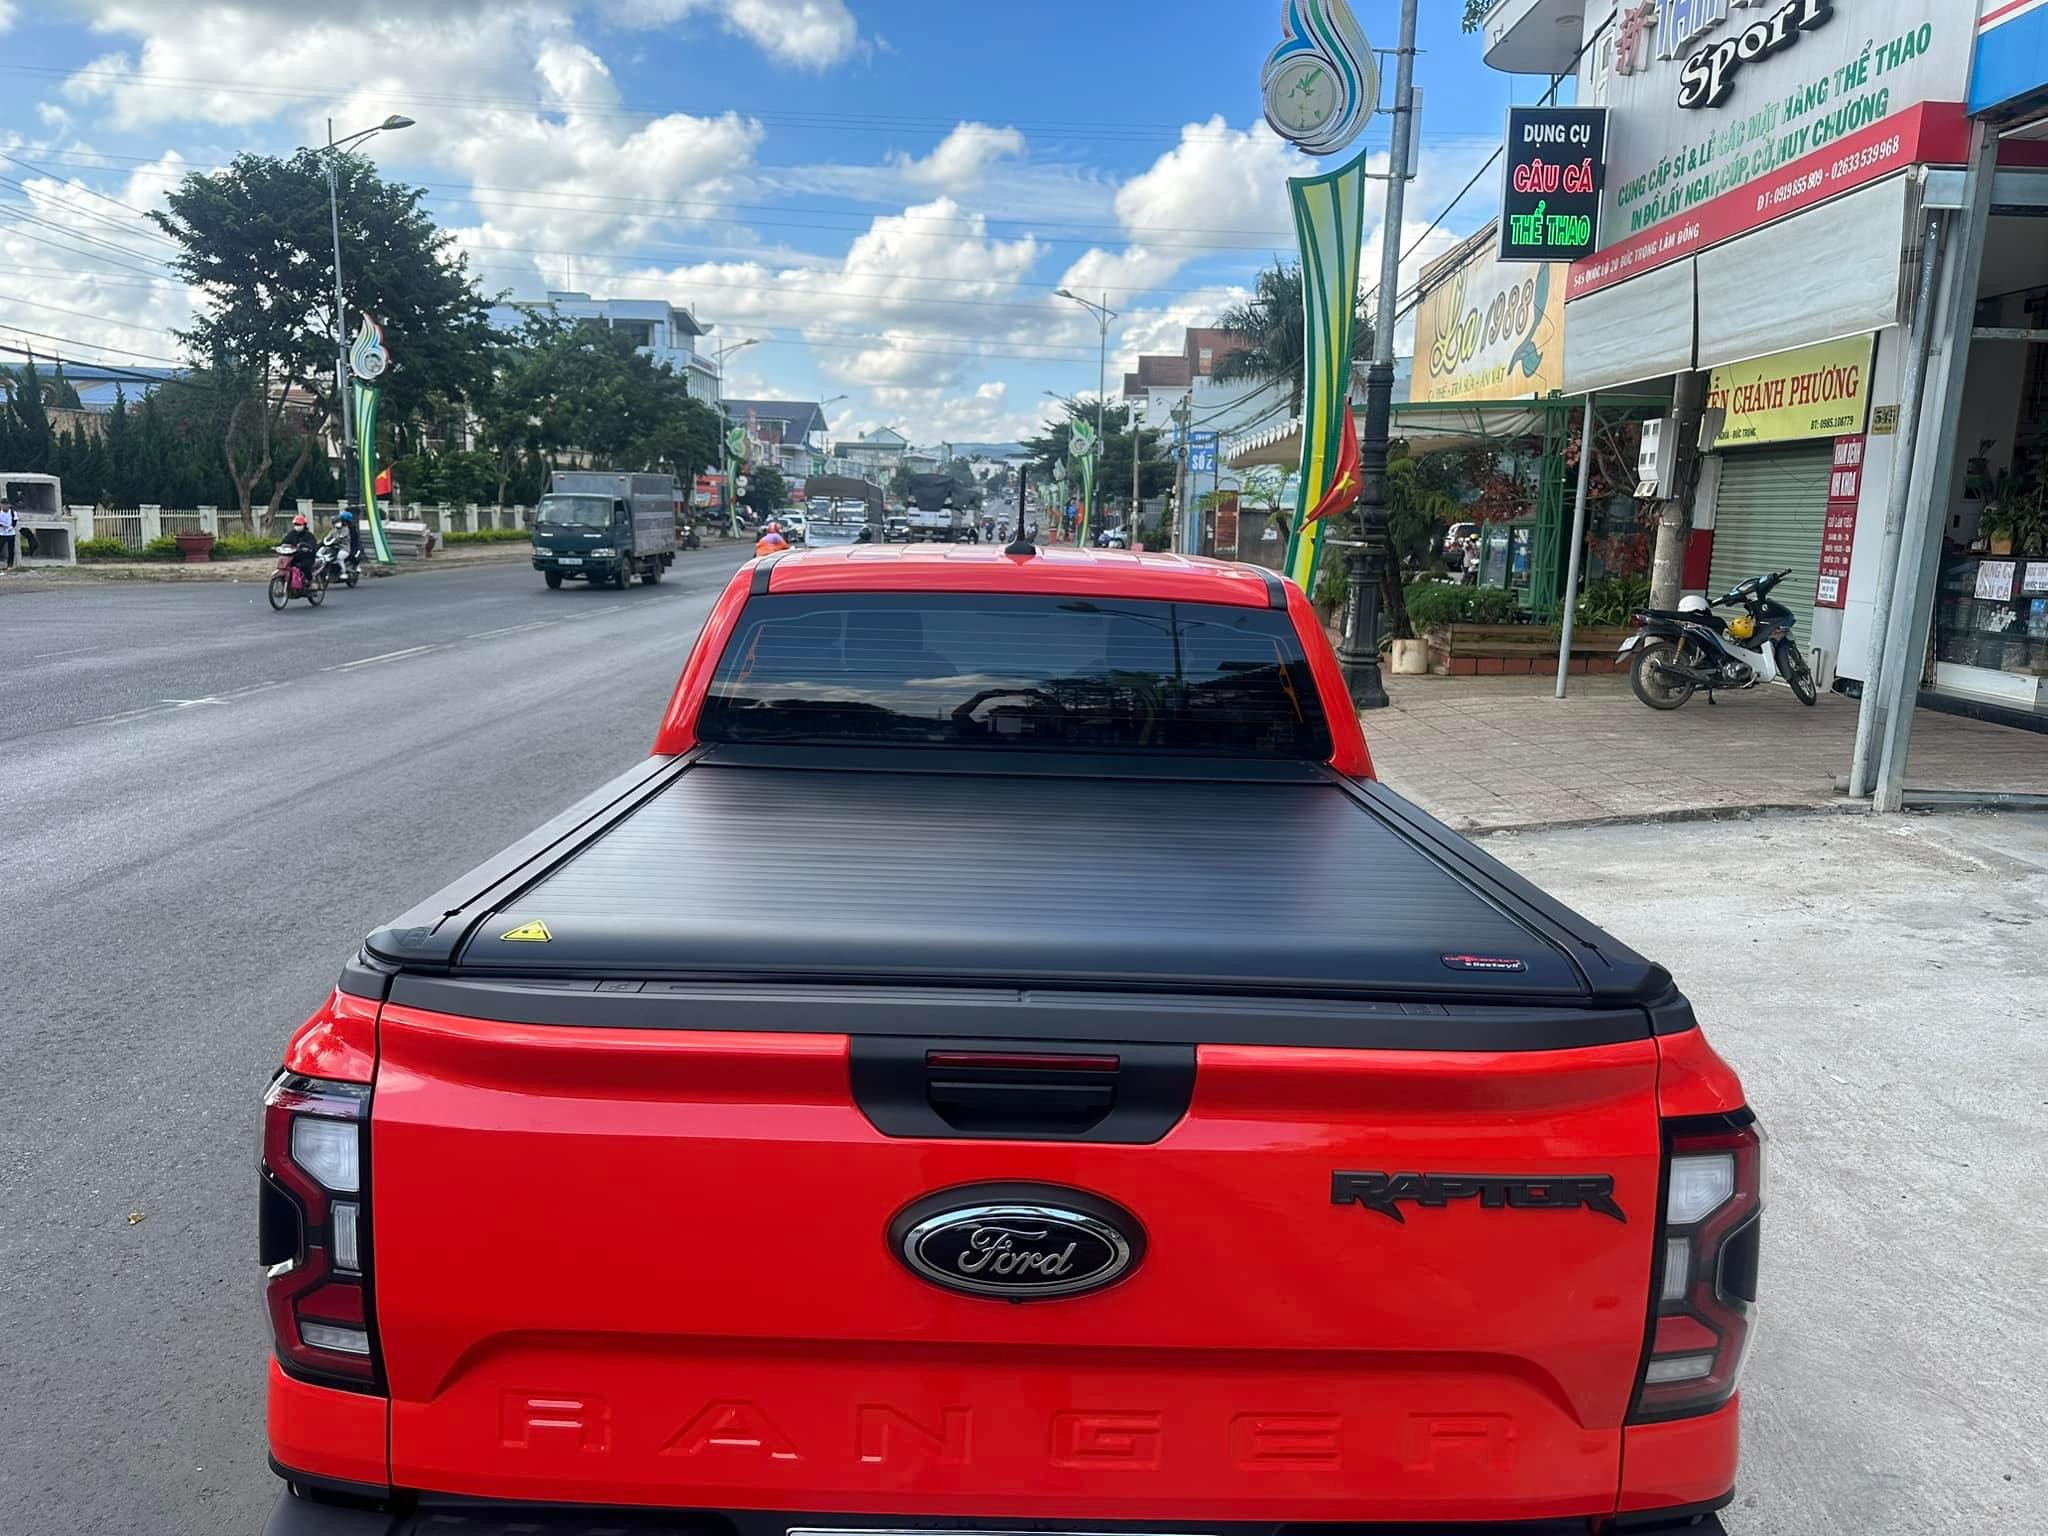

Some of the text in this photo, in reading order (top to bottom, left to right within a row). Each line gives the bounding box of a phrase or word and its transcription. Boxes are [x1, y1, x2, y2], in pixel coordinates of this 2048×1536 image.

[1524, 124, 1591, 148] DỤNG CỤ
[1618, 175, 1646, 207] CUNG
[1649, 156, 1671, 191] CẤP
[1688, 149, 1697, 172] &
[1783, 77, 1829, 124] HÀNG
[1834, 39, 1873, 97] THỂ
[1875, 23, 1932, 76] THAO
[1514, 158, 1593, 193] CÂU CÁ
[1631, 209, 1643, 232] IN
[1643, 191, 1660, 226] ĐỒ
[1661, 183, 1684, 219] LẤY
[1812, 88, 1889, 147] CHƯƠNG
[1510, 200, 1591, 246] THỂ THAO
[1659, 232, 1675, 252] LÂM
[1677, 220, 1700, 246] ĐỒNG
[1480, 278, 1534, 354] 1988
[1732, 374, 1786, 415] CHÁNH
[1788, 363, 1859, 407] PHƯƠNG
[1331, 1169, 1627, 1224] RAPTOR
[958, 1227, 1077, 1275] Ford
[500, 1386, 1520, 1475] RANGER
